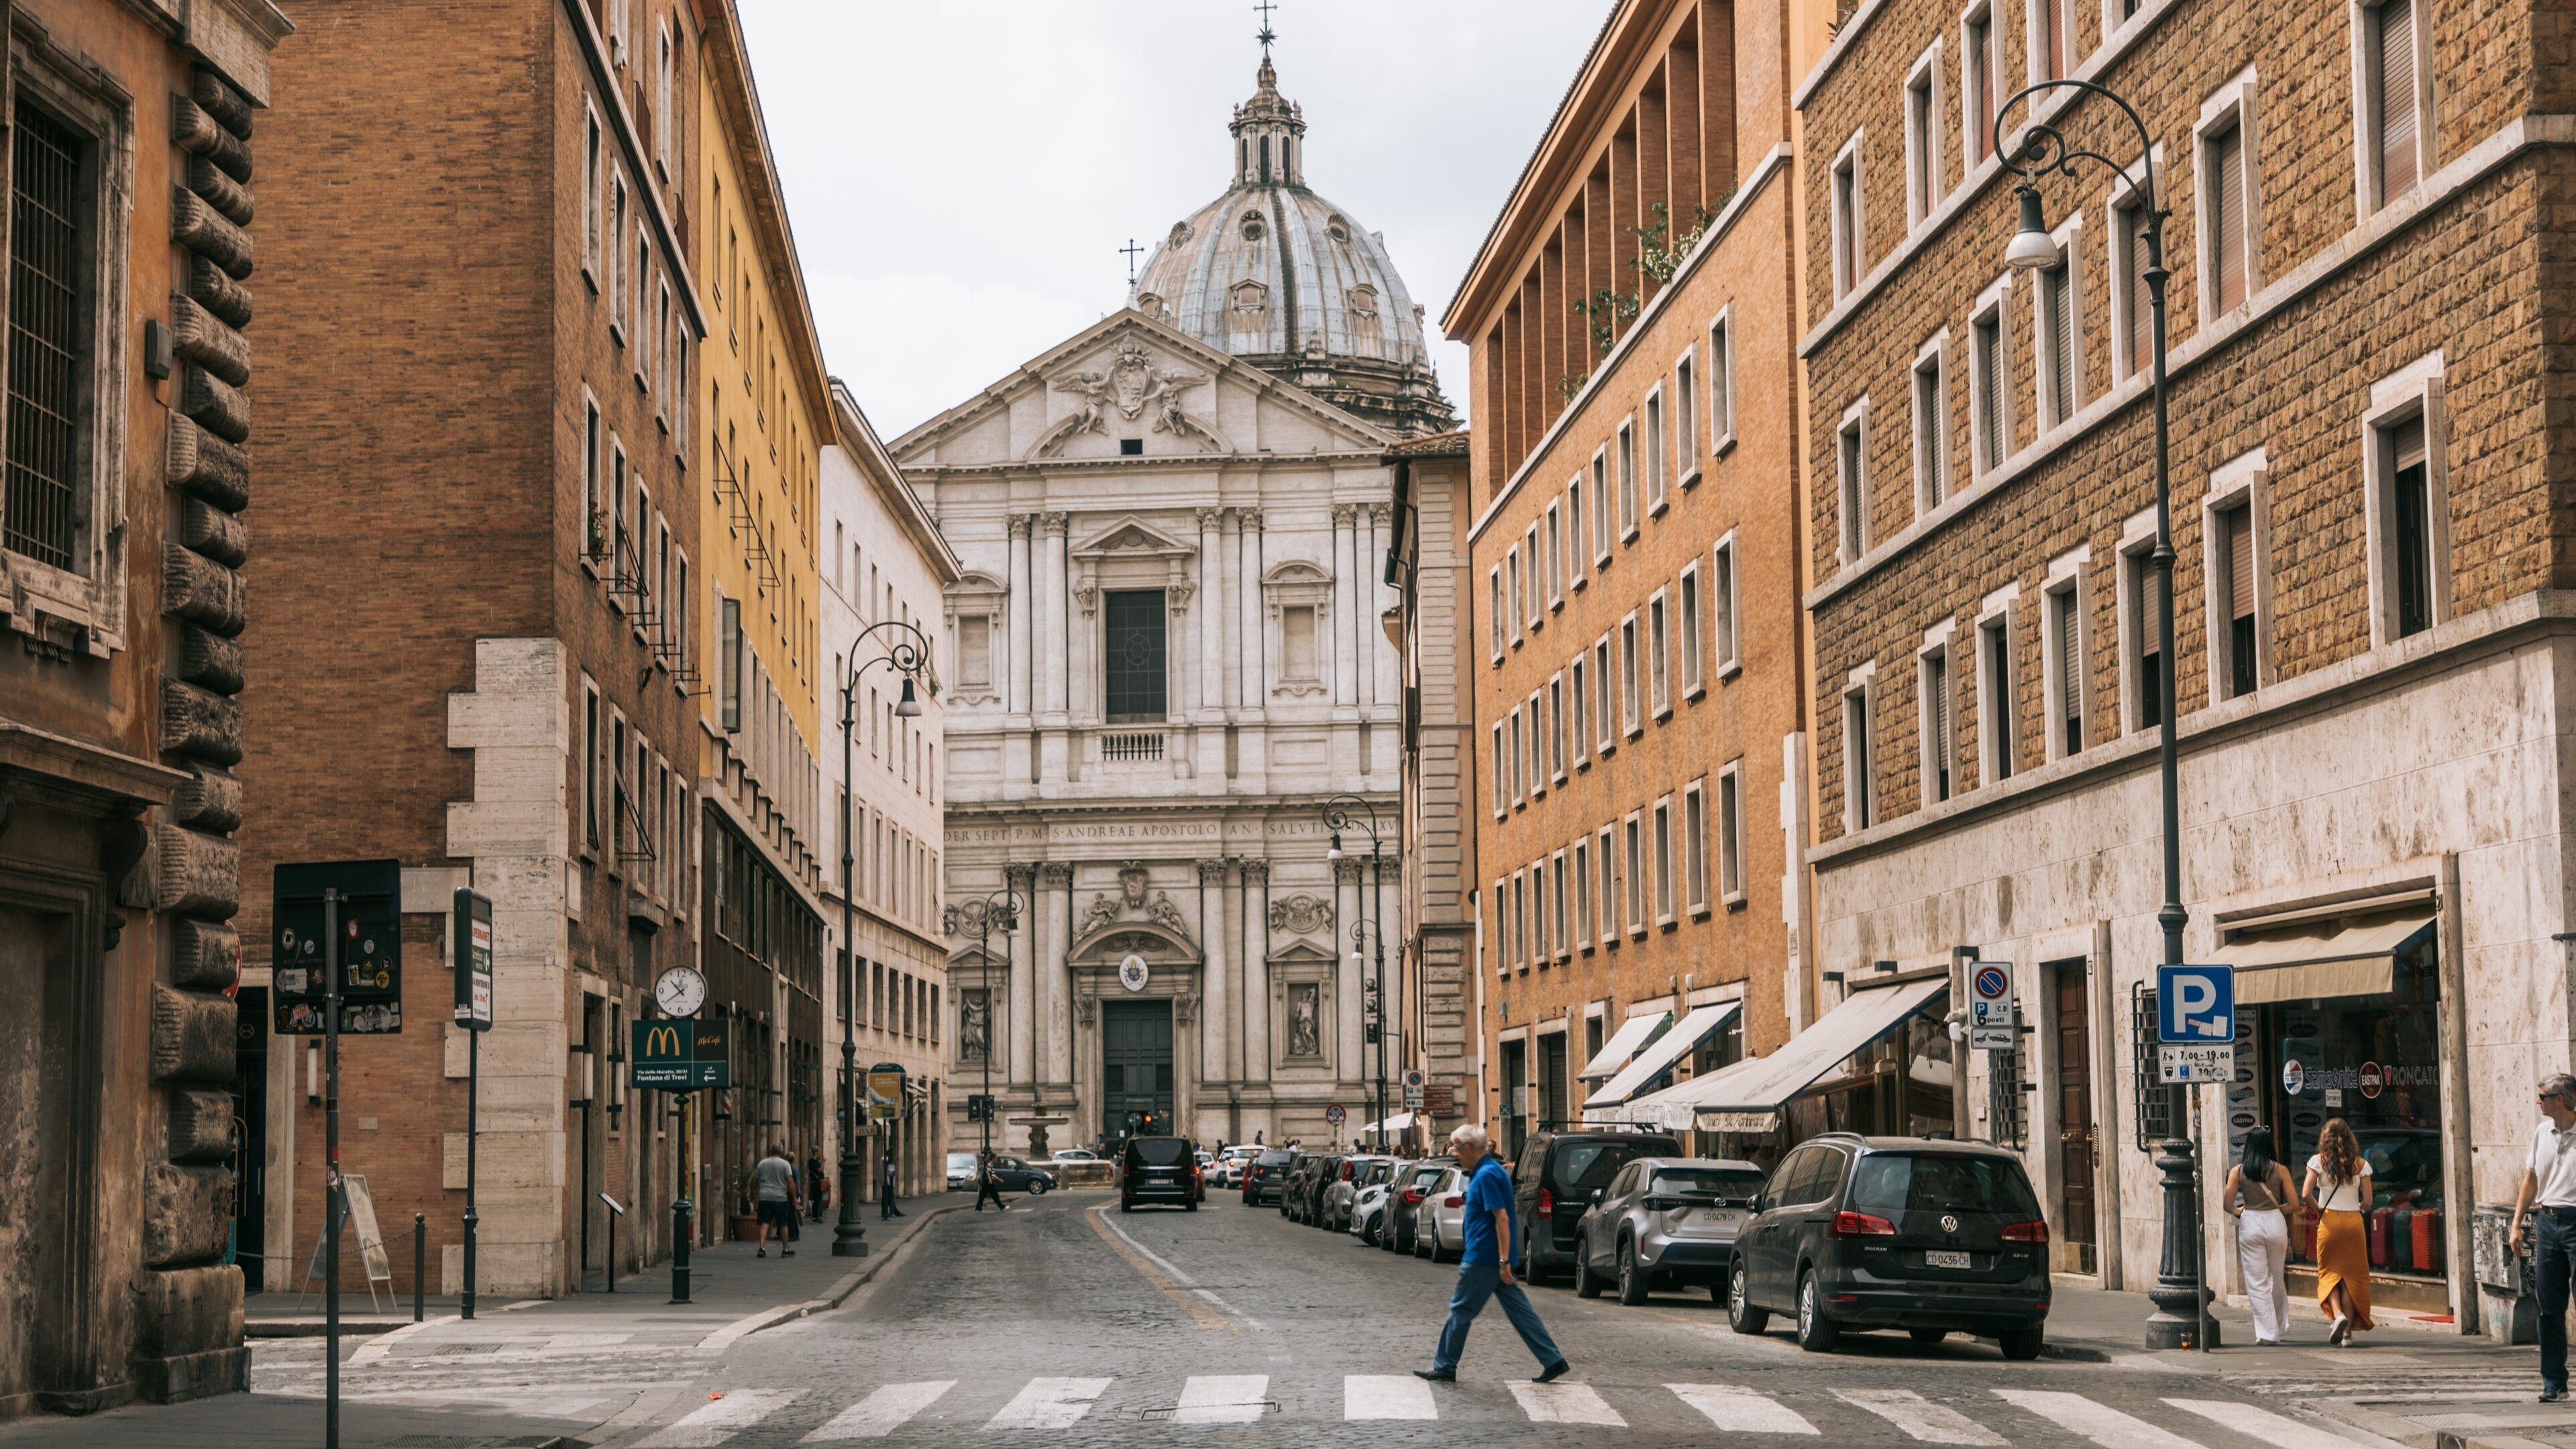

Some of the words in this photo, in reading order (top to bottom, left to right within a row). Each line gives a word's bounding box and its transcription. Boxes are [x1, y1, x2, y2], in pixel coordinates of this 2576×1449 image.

[1141, 824, 1216, 837] APOSTOLO
[677, 969, 687, 979] 12
[659, 987, 664, 996] 9
[698, 987, 704, 996] 3
[2173, 975, 2216, 1033] P
[678, 1005, 684, 1014] 6
[672, 1073, 687, 1081] Trevi
[2306, 1067, 2358, 1089] Samsonite
[2361, 1075, 2380, 1086] EASTPAK
[1938, 1254, 1957, 1265] 0436
[1959, 1255, 1970, 1266] CH
